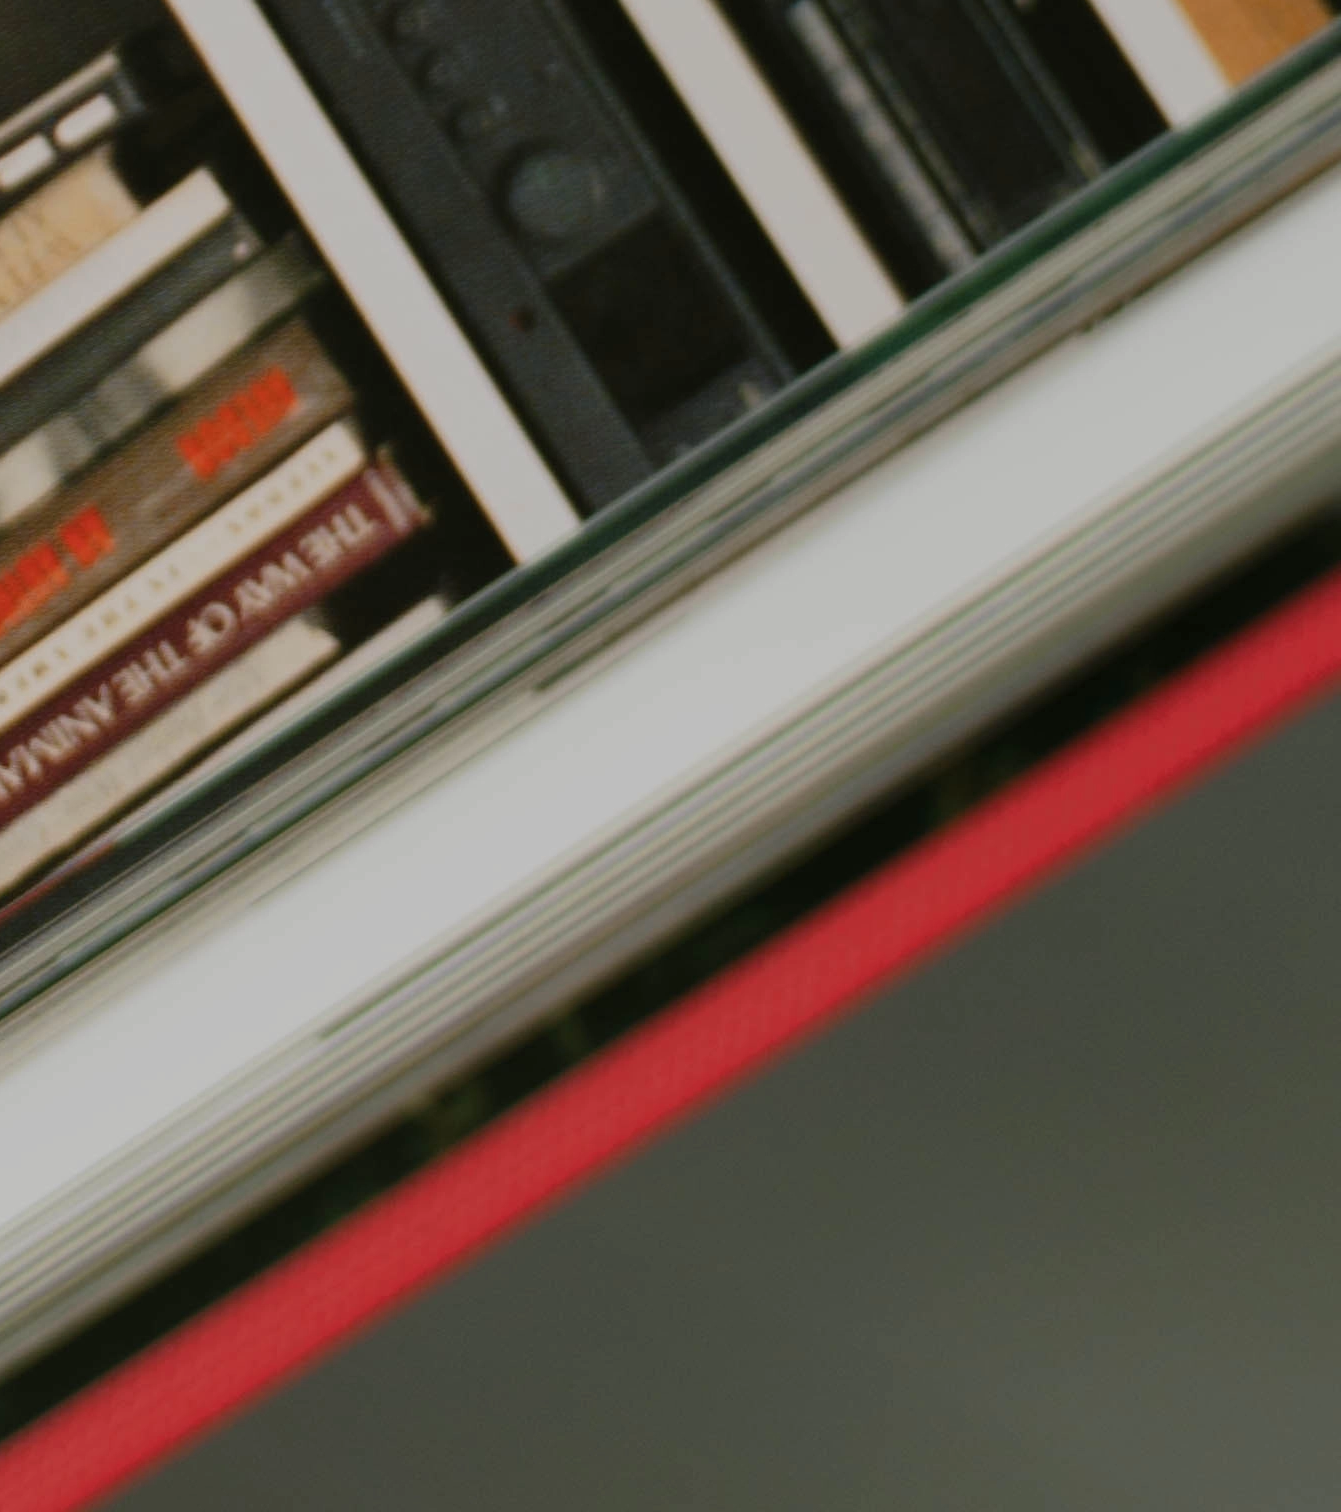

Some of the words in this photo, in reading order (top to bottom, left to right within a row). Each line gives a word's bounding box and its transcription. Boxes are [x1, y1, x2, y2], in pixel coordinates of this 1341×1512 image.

[299, 501, 373, 568] THE
[228, 547, 309, 620] WAY
[177, 596, 239, 658] OF
[111, 636, 187, 704] THE
